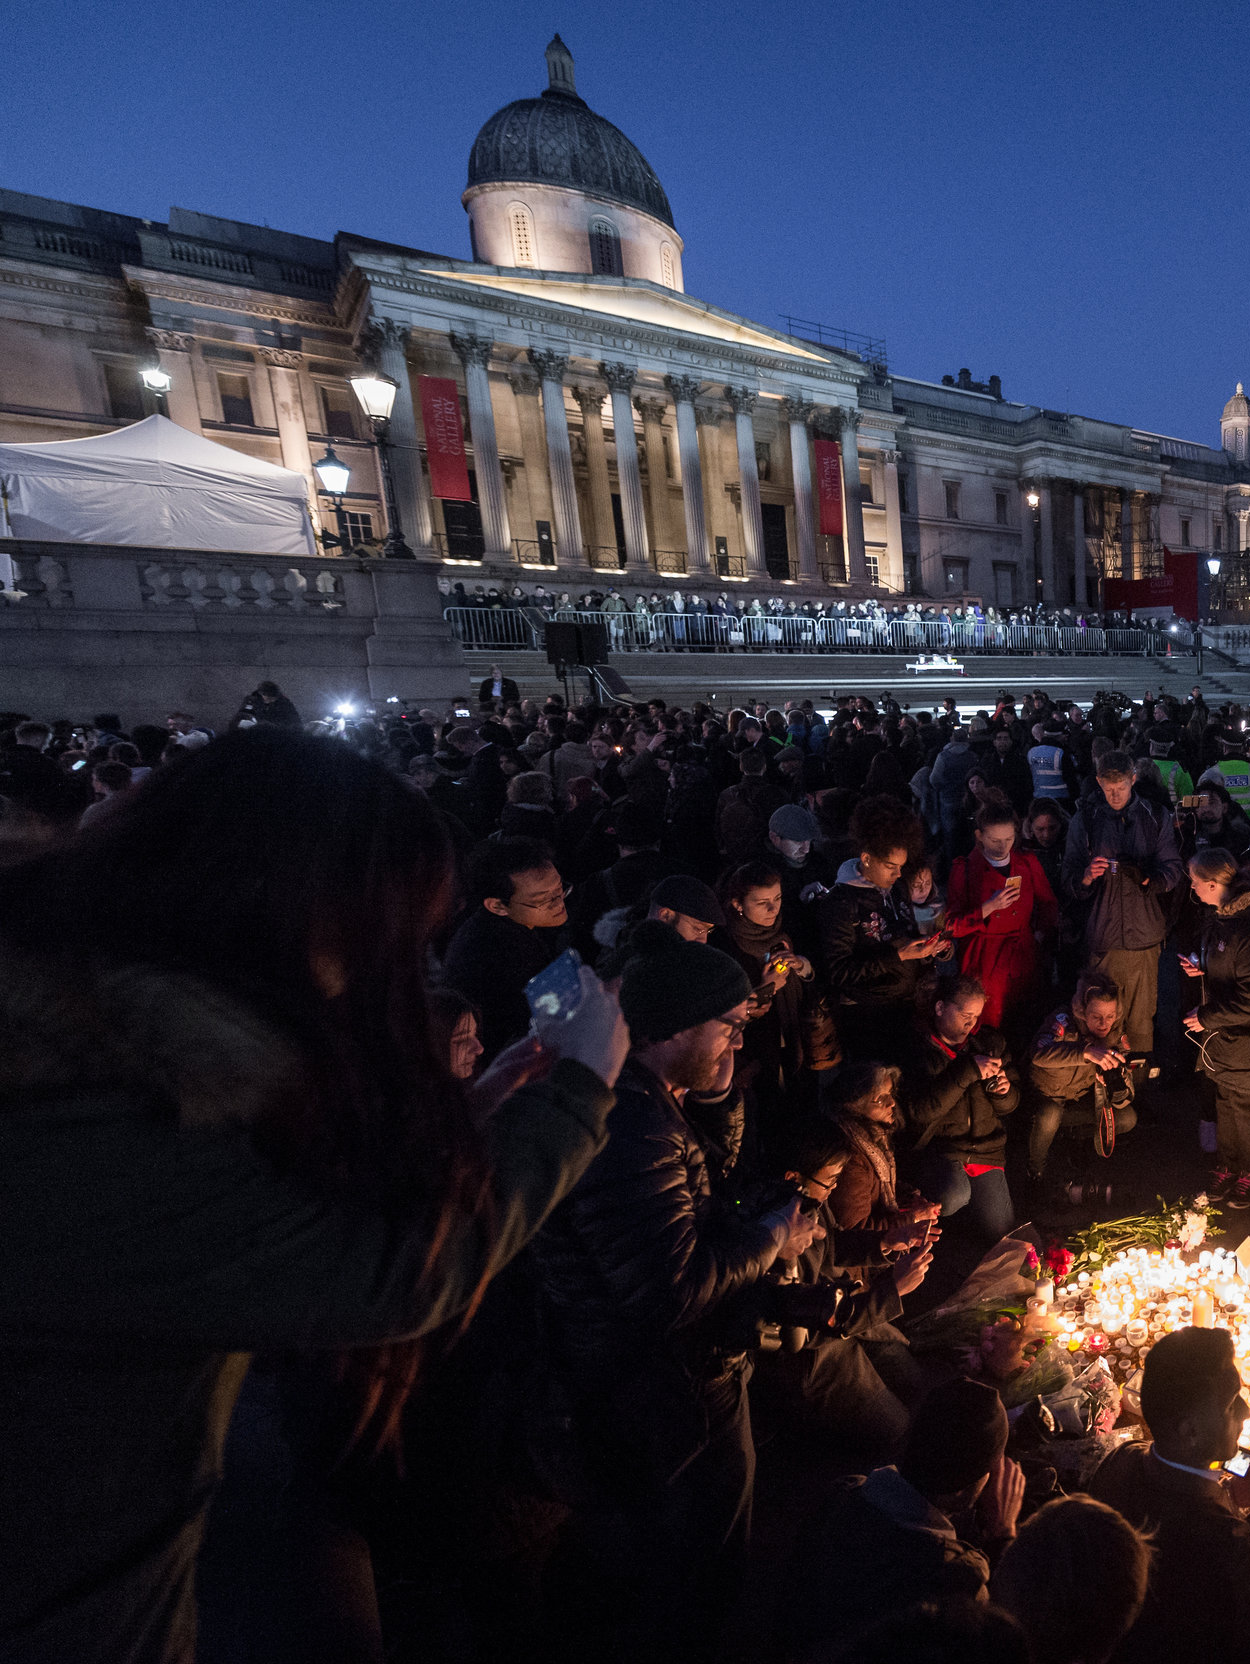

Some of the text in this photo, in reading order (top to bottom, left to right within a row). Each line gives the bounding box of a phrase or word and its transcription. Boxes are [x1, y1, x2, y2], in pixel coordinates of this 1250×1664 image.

[431, 397, 448, 453] NATIONAL
[443, 398, 461, 456] GALLERY
[823, 456, 833, 500] NATIONAL
